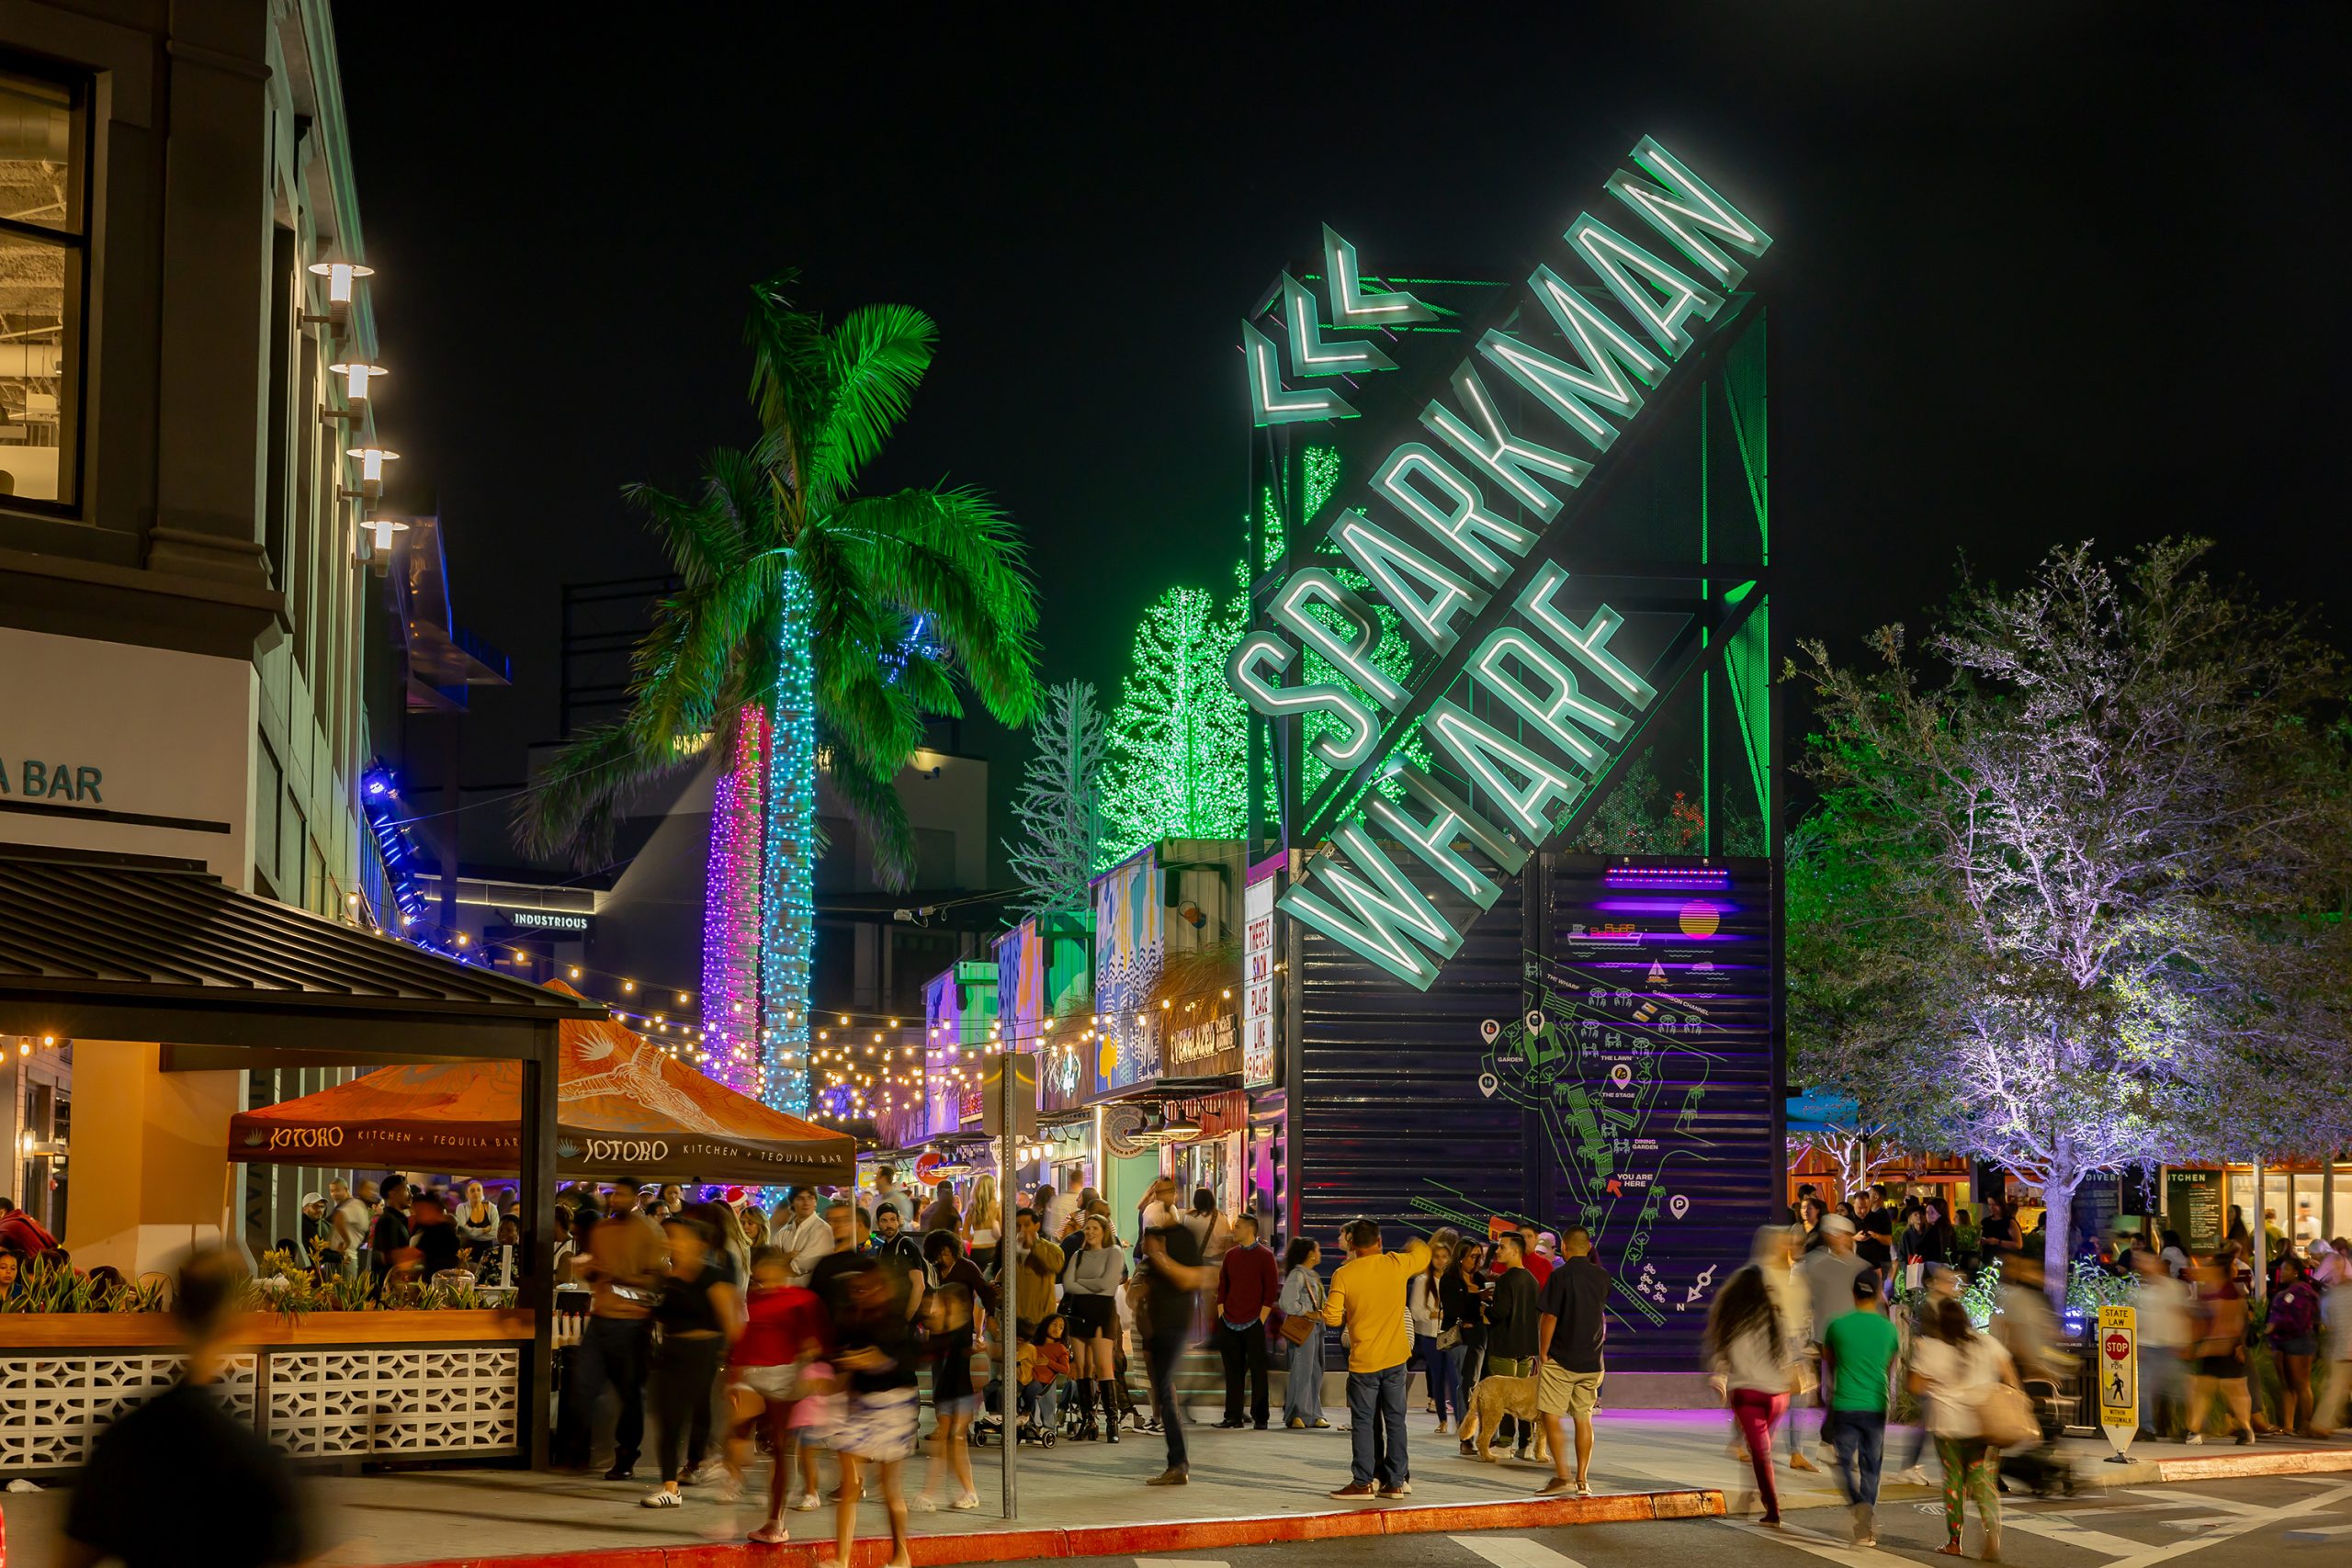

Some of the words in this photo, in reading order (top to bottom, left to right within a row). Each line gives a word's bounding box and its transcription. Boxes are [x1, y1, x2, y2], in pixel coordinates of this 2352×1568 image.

[1226, 133, 1774, 770] SPARKMAN
[23, 760, 103, 804] BAR
[1276, 558, 1658, 992] WHARF
[514, 913, 588, 930] INDUSTRIOUS
[1249, 919, 1270, 952] THERE'S
[1252, 953, 1267, 984] SNOW
[1546, 973, 1558, 982] THE
[1557, 977, 1580, 990] WHARF
[1251, 986, 1268, 1016] PLACE
[1652, 989, 1683, 1006] GARRISON
[1682, 1000, 1710, 1016] CHANNEL
[1254, 1020, 1266, 1049] LIKE
[1103, 1108, 1140, 1131] EVERGLA
[268, 1126, 344, 1151] JOTORO
[357, 1130, 411, 1143] KITCHEN
[434, 1134, 486, 1147] TEQUILA
[495, 1138, 519, 1147] BAR
[583, 1138, 668, 1164] JOTORO
[683, 1145, 738, 1157] KITCHEN
[761, 1151, 813, 1164] TEQUILA
[821, 1154, 842, 1164] BAR
[1676, 1200, 1683, 1208] P
[1676, 1303, 1685, 1312] N
[2105, 1309, 2129, 1318] STATE
[2106, 1342, 2129, 1352] STOP
[2104, 1416, 2132, 1424] CROSSWALK
